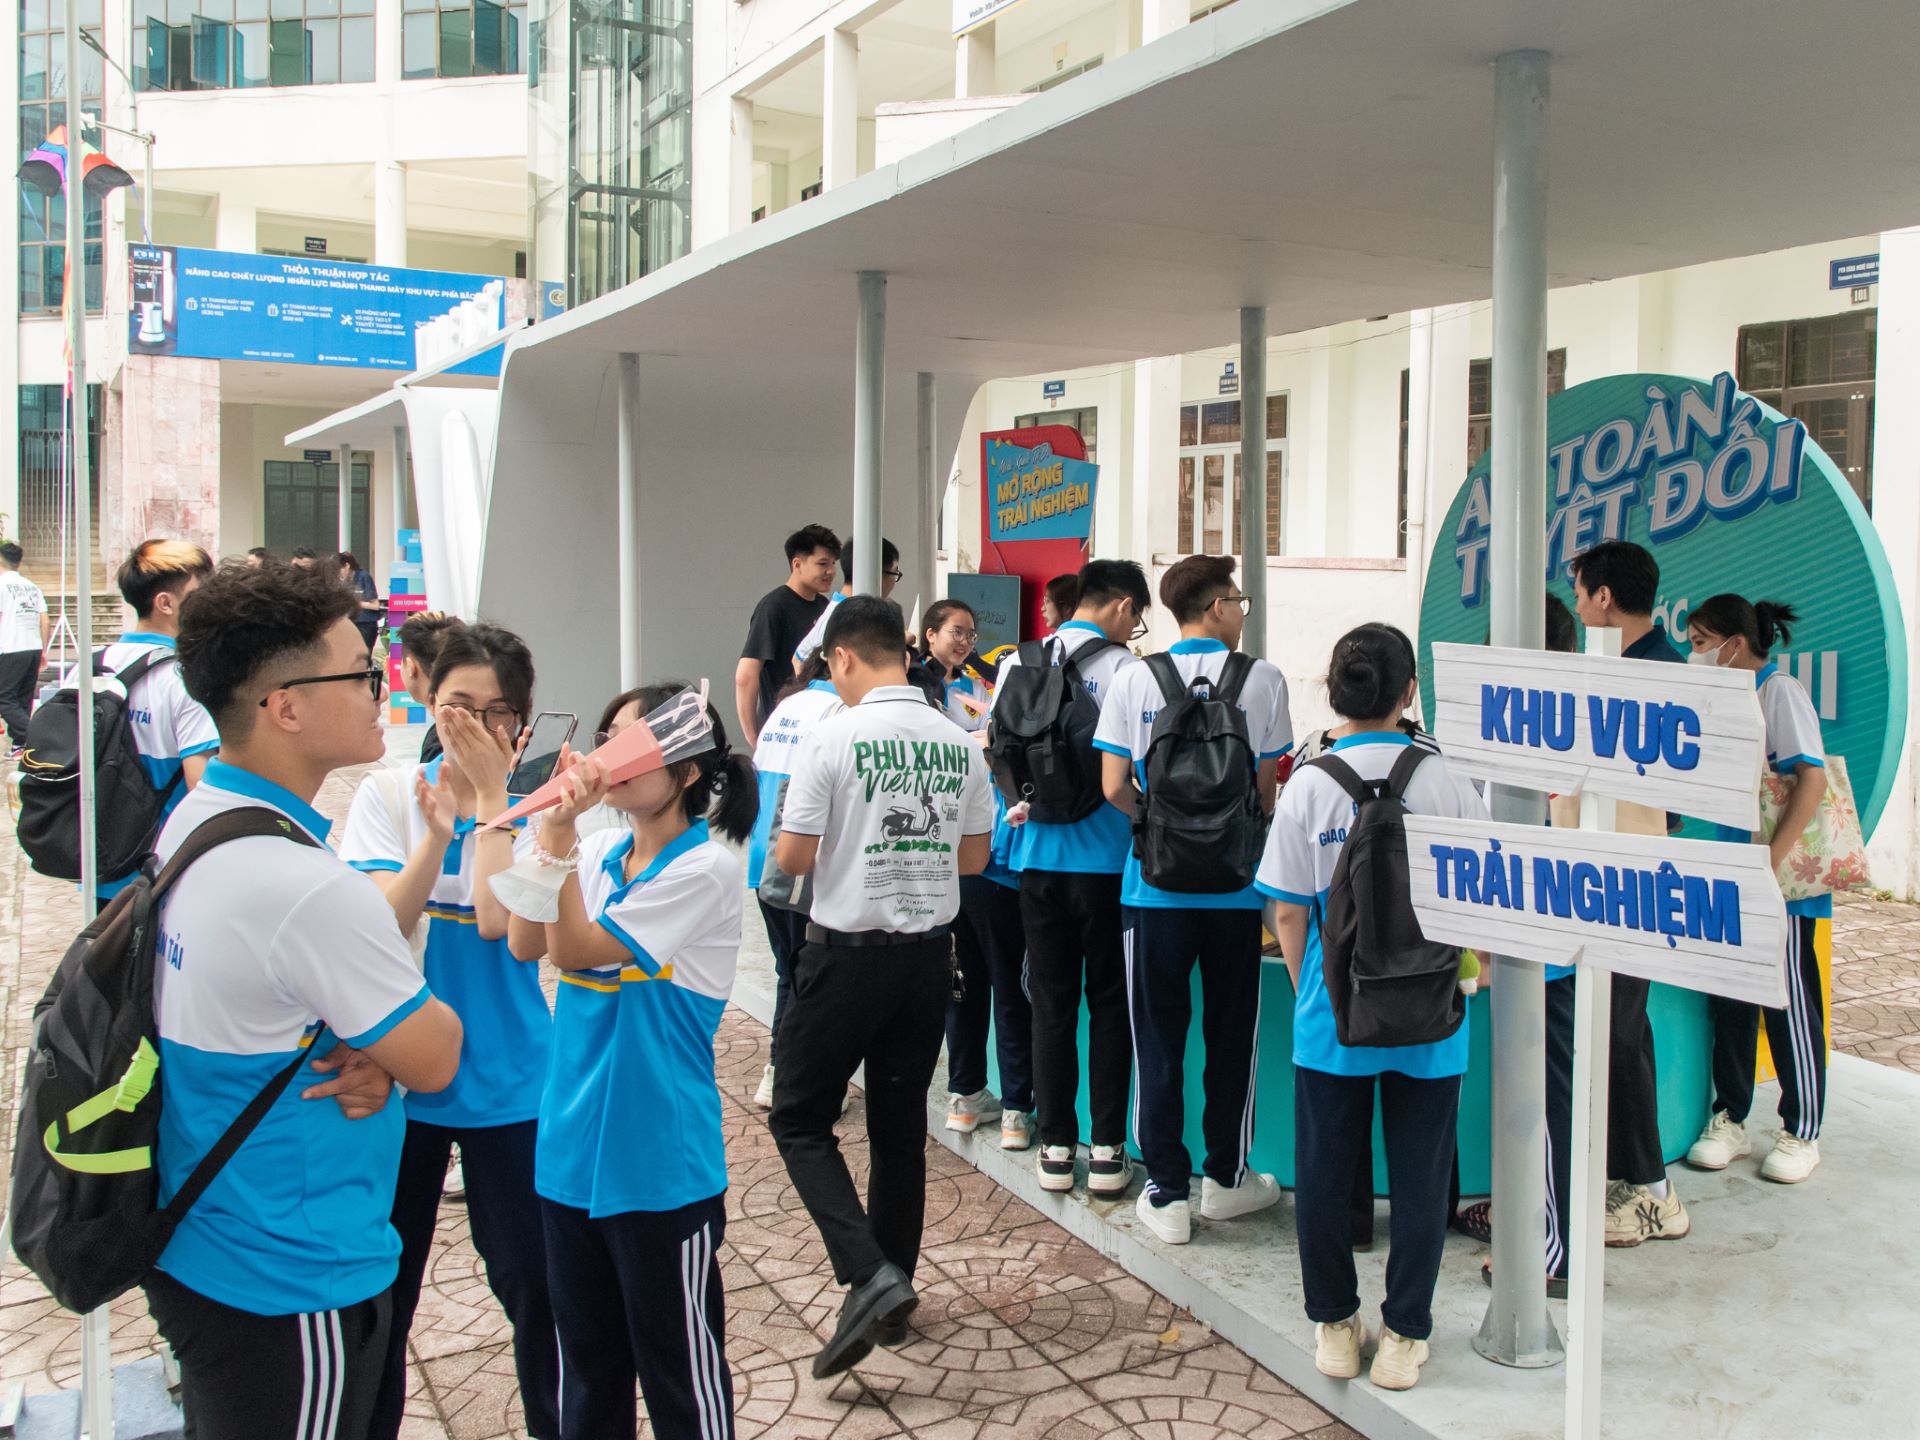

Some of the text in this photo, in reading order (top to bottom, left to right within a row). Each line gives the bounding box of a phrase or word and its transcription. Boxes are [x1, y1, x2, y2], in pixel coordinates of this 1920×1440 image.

[133, 248, 161, 259] KONE
[282, 264, 390, 282] THỎA THUẬN HỢP TÁC
[185, 267, 210, 277] NÂNG
[211, 270, 230, 279] CAO
[231, 269, 254, 280] CHẤT
[255, 274, 285, 284] LƯỢNG
[287, 276, 310, 286] NHÂN
[311, 278, 328, 288] LỰC
[329, 279, 358, 290] NGÀNH
[360, 283, 386, 292] THANG
[387, 285, 405, 294] MÁY
[406, 287, 422, 295] KHU
[423, 288, 440, 298] VỰC
[441, 289, 459, 299] PHÍA
[1550, 370, 1739, 501] TOÀN
[1021, 462, 1064, 498] RỘNG
[998, 482, 1089, 532] TRẢI NGHIỆM
[1455, 397, 1807, 608] TỆT ĐỐI
[1481, 683, 1701, 777] KHU VỰC
[854, 734, 969, 776] PHỦ XANH
[858, 757, 966, 803] Việt Nam
[1318, 828, 1347, 847] GIAO
[1430, 837, 1742, 949] TRẢI NGHIỆM
[168, 933, 184, 971] TẢI
